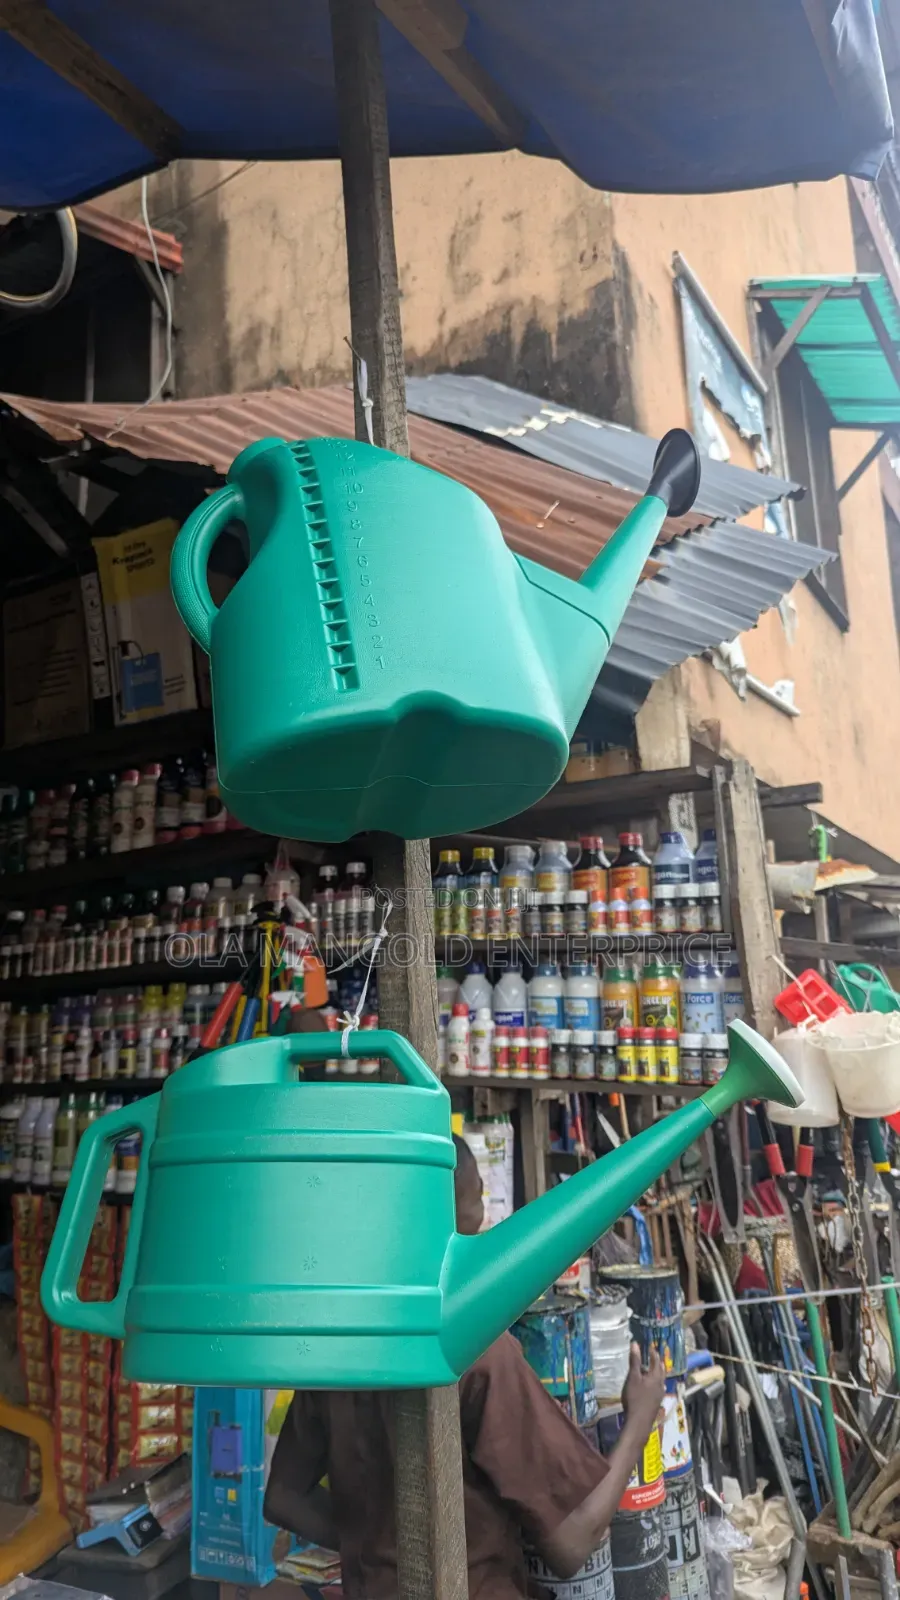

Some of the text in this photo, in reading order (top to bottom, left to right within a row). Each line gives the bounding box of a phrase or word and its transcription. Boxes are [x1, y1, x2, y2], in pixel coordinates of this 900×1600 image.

[343, 482, 364, 494] 10
[347, 500, 358, 512] 9
[350, 519, 362, 531] 8
[353, 537, 364, 549] 7
[356, 555, 369, 568] 6
[360, 574, 372, 587] 5
[364, 594, 375, 607] 4
[367, 614, 381, 628] 3
[371, 635, 384, 649] 2
[375, 655, 386, 670] 1
